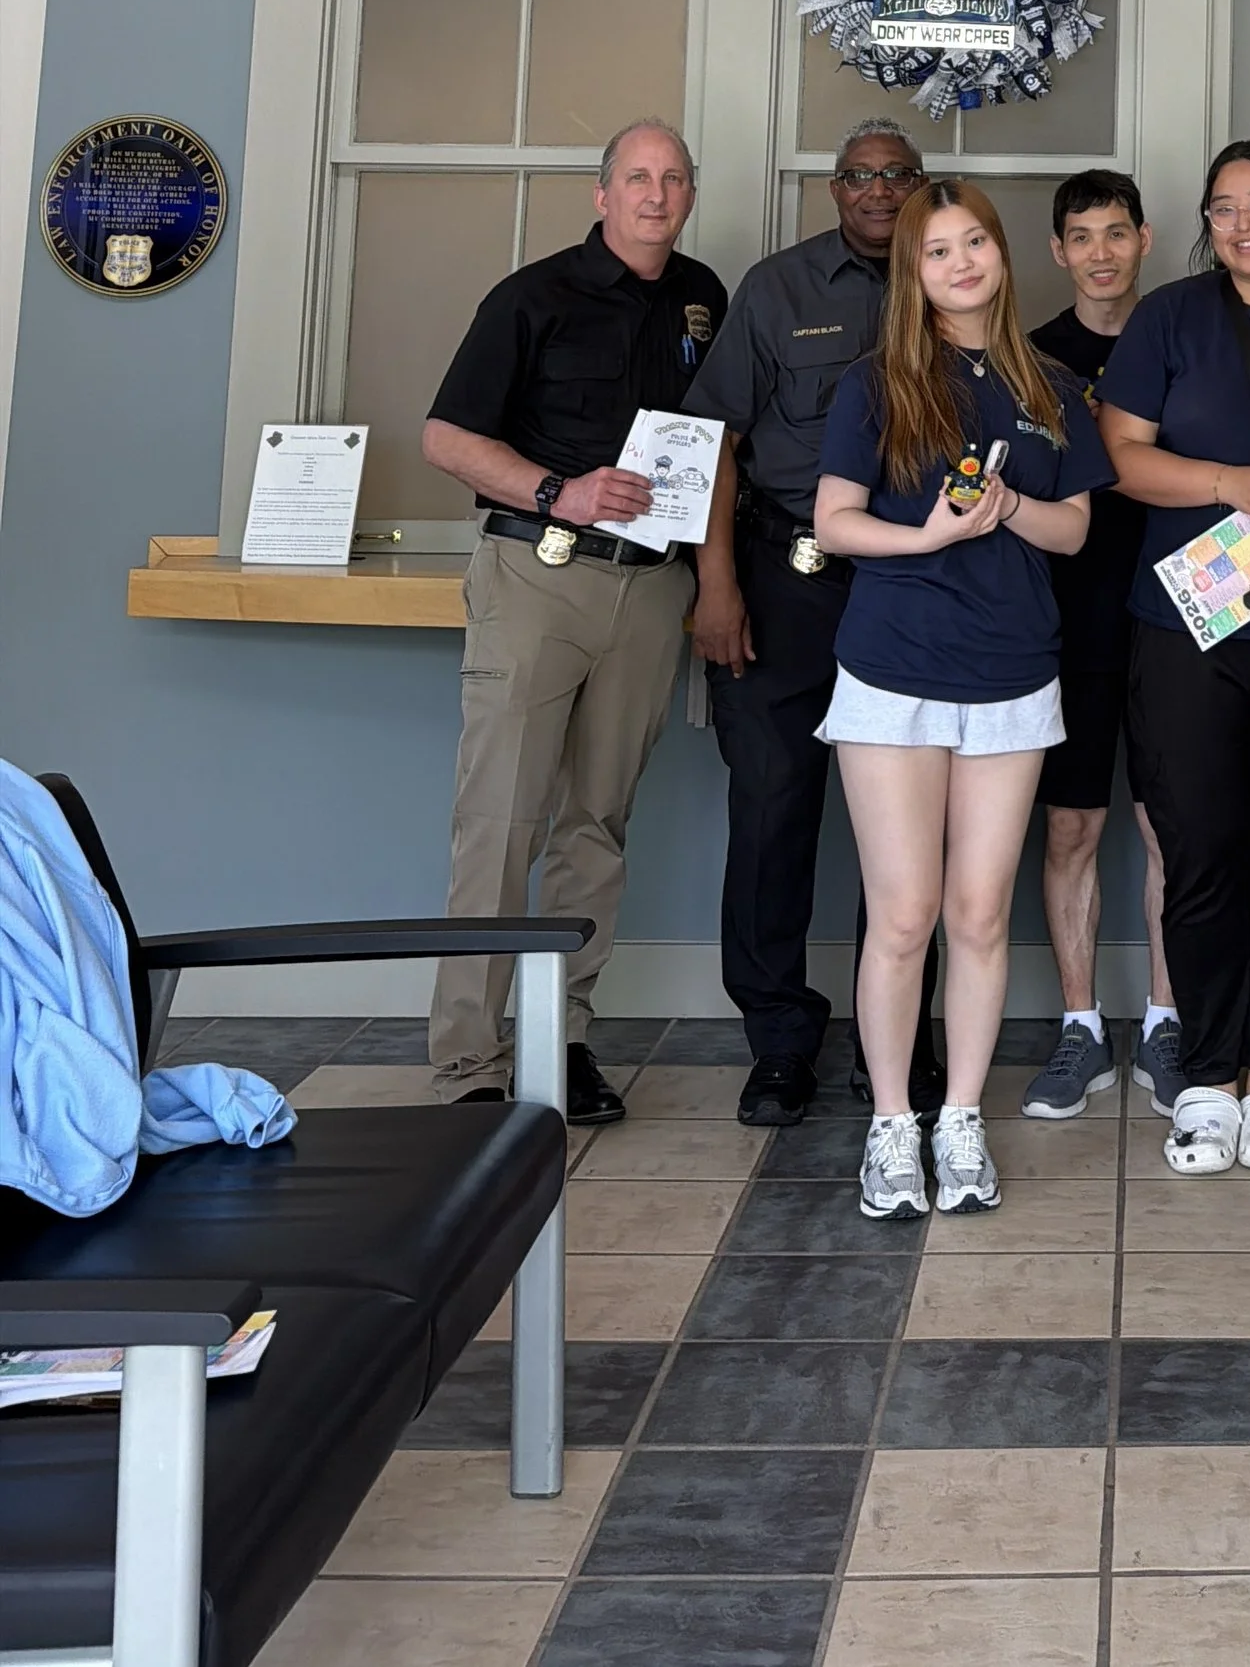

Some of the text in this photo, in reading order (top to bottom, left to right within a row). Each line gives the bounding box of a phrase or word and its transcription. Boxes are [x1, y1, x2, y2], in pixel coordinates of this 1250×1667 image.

[877, 25, 1009, 44] DON'T WEAR CAPES
[162, 127, 204, 166] OATH
[47, 122, 155, 216] ENFORCEMENT
[202, 172, 218, 194] OF
[48, 226, 78, 263] LAW
[178, 204, 218, 268] HONOR
[792, 325, 843, 337] CAPTAIN BLACK
[655, 421, 714, 444] THANK YOU!
[671, 433, 689, 441] POLICE
[1178, 589, 1216, 644] 2026
